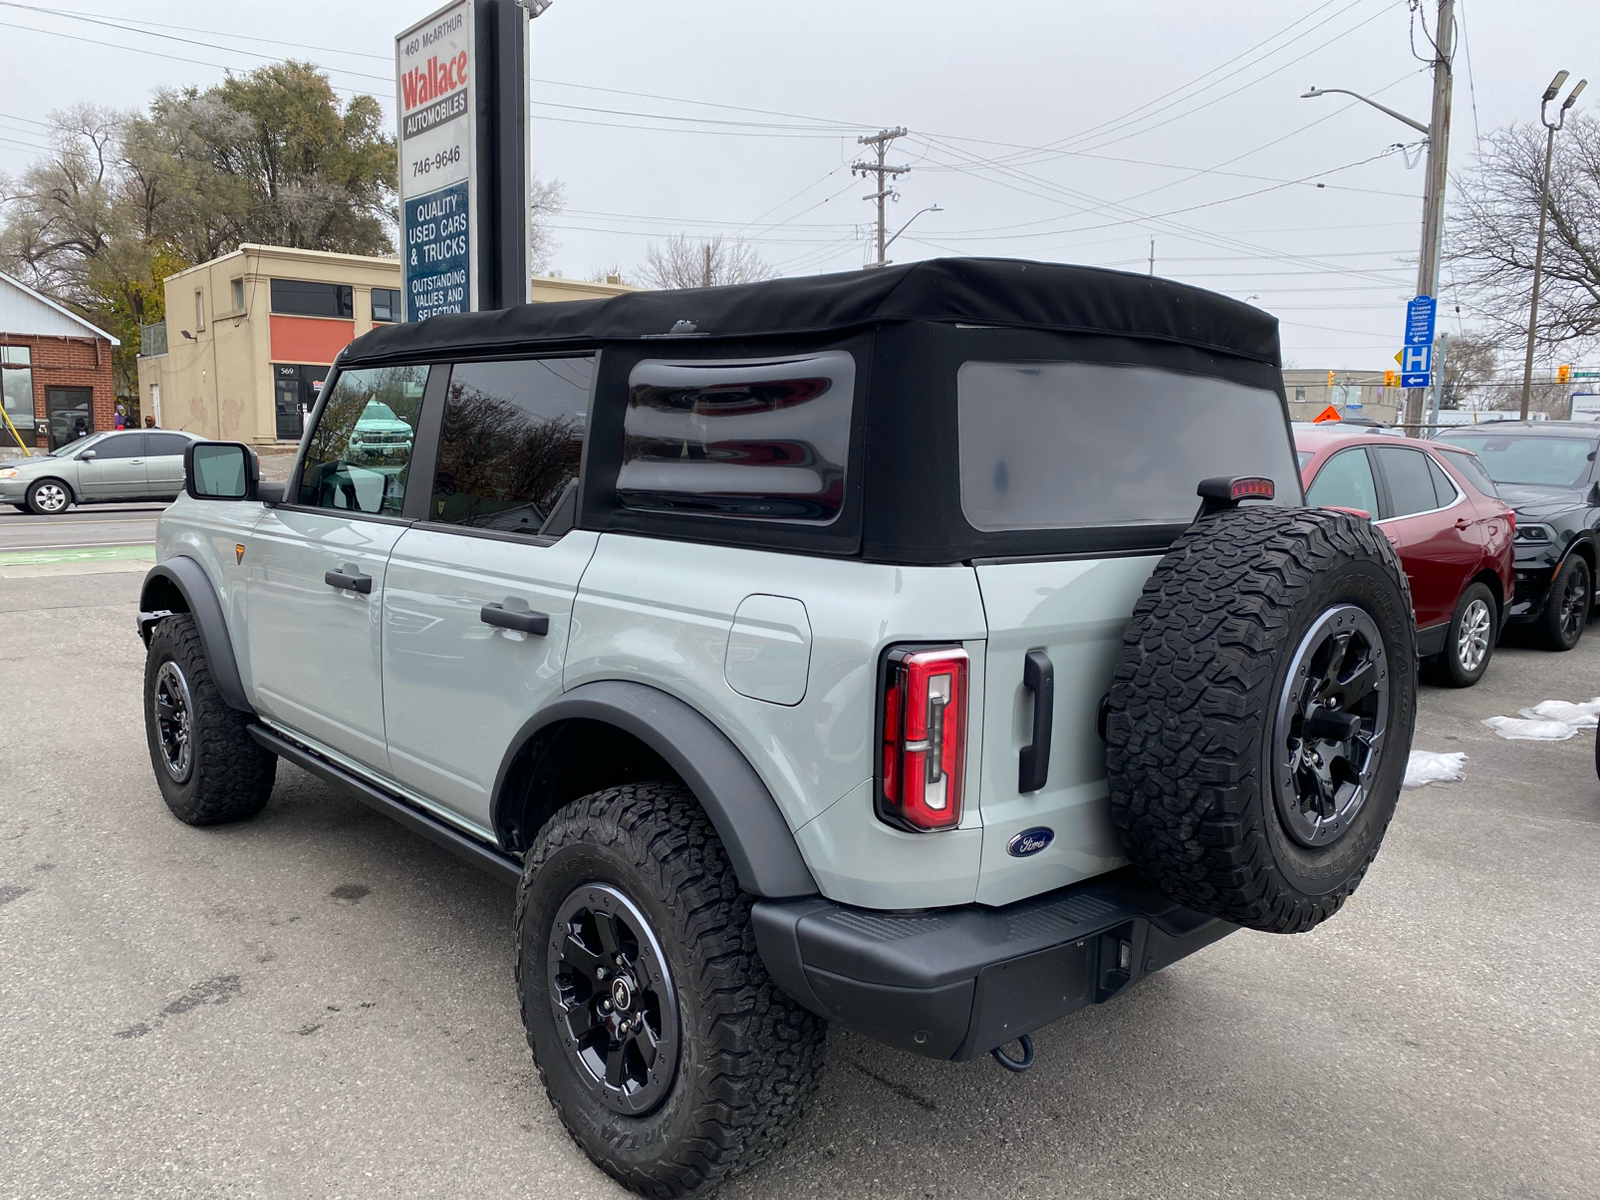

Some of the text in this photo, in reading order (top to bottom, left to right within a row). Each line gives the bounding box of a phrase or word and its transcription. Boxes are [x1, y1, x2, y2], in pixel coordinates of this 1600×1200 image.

[405, 13, 463, 57] 460 McARTHUR
[401, 50, 468, 111] Wallace
[406, 93, 465, 135] AUTOMOBILES
[412, 145, 461, 178] 746-9646
[417, 194, 458, 222] QUALITY
[409, 213, 467, 245] USED CARS
[410, 235, 466, 266] & TRUCKS
[411, 269, 466, 294] OUTSTANDING
[414, 287, 464, 308] VALUES AND
[280, 367, 294, 375] 569
[1406, 347, 1428, 371] H
